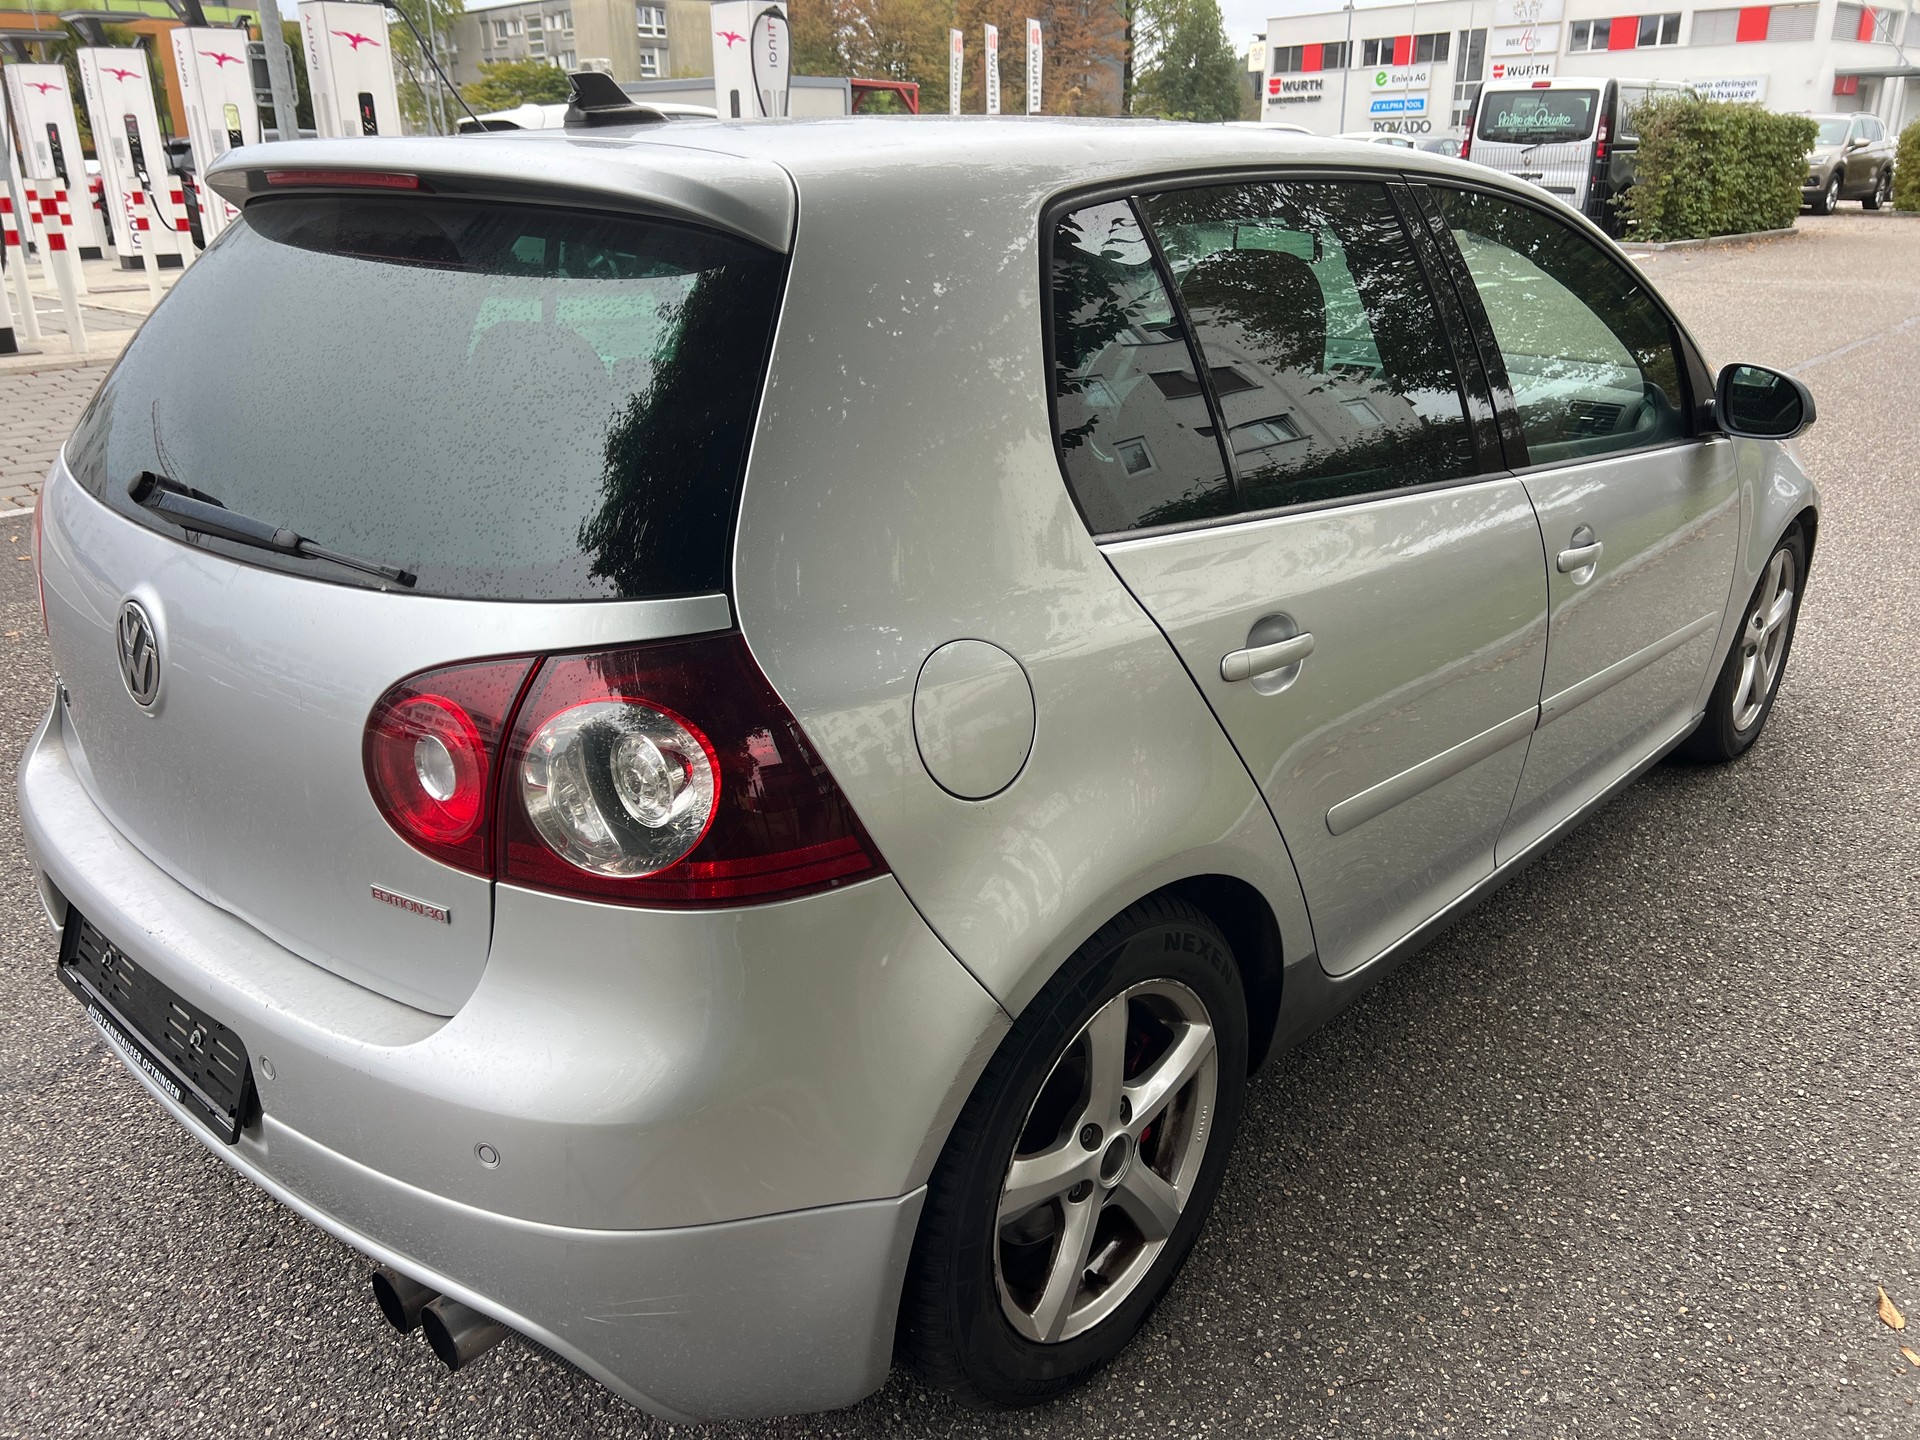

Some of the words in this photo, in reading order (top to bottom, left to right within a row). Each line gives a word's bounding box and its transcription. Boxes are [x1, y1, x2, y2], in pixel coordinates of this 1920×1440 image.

[1415, 73, 1426, 81] AG
[1507, 64, 1550, 76] WÜRTH
[1282, 79, 1323, 92] WÜRTH
[372, 888, 424, 915] EDITION
[425, 905, 445, 922] 30
[1164, 931, 1233, 985] NEXEN
[87, 1003, 103, 1023] AUTO
[102, 1018, 142, 1064] FANKHAUSER
[142, 1058, 181, 1100] OFTRINGEN
